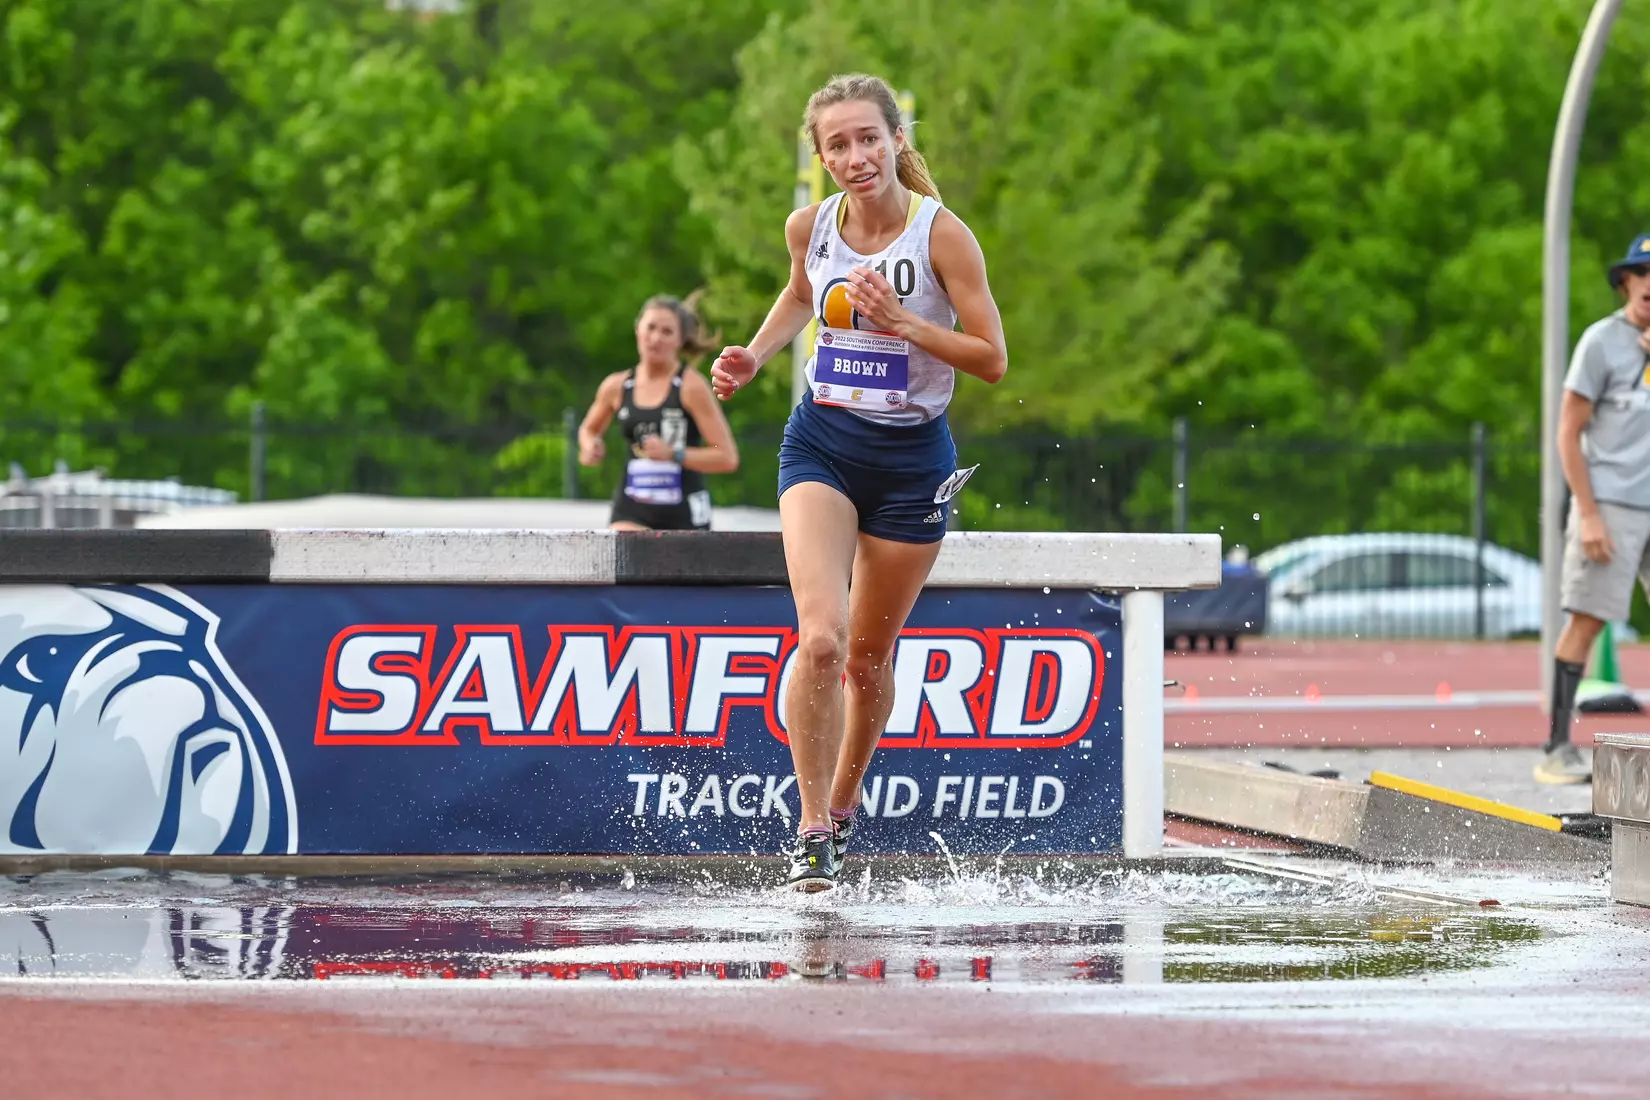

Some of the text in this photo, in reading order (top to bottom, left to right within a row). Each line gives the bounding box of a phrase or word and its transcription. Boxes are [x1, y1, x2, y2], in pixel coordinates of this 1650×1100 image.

[874, 258, 916, 297] 10
[846, 336, 872, 345] SOUTHERN
[872, 339, 906, 349] CONFERENCE
[833, 357, 888, 377] BROWN
[314, 624, 1104, 748] SAMFRD
[627, 772, 1066, 818] TRACK ND FIELD
